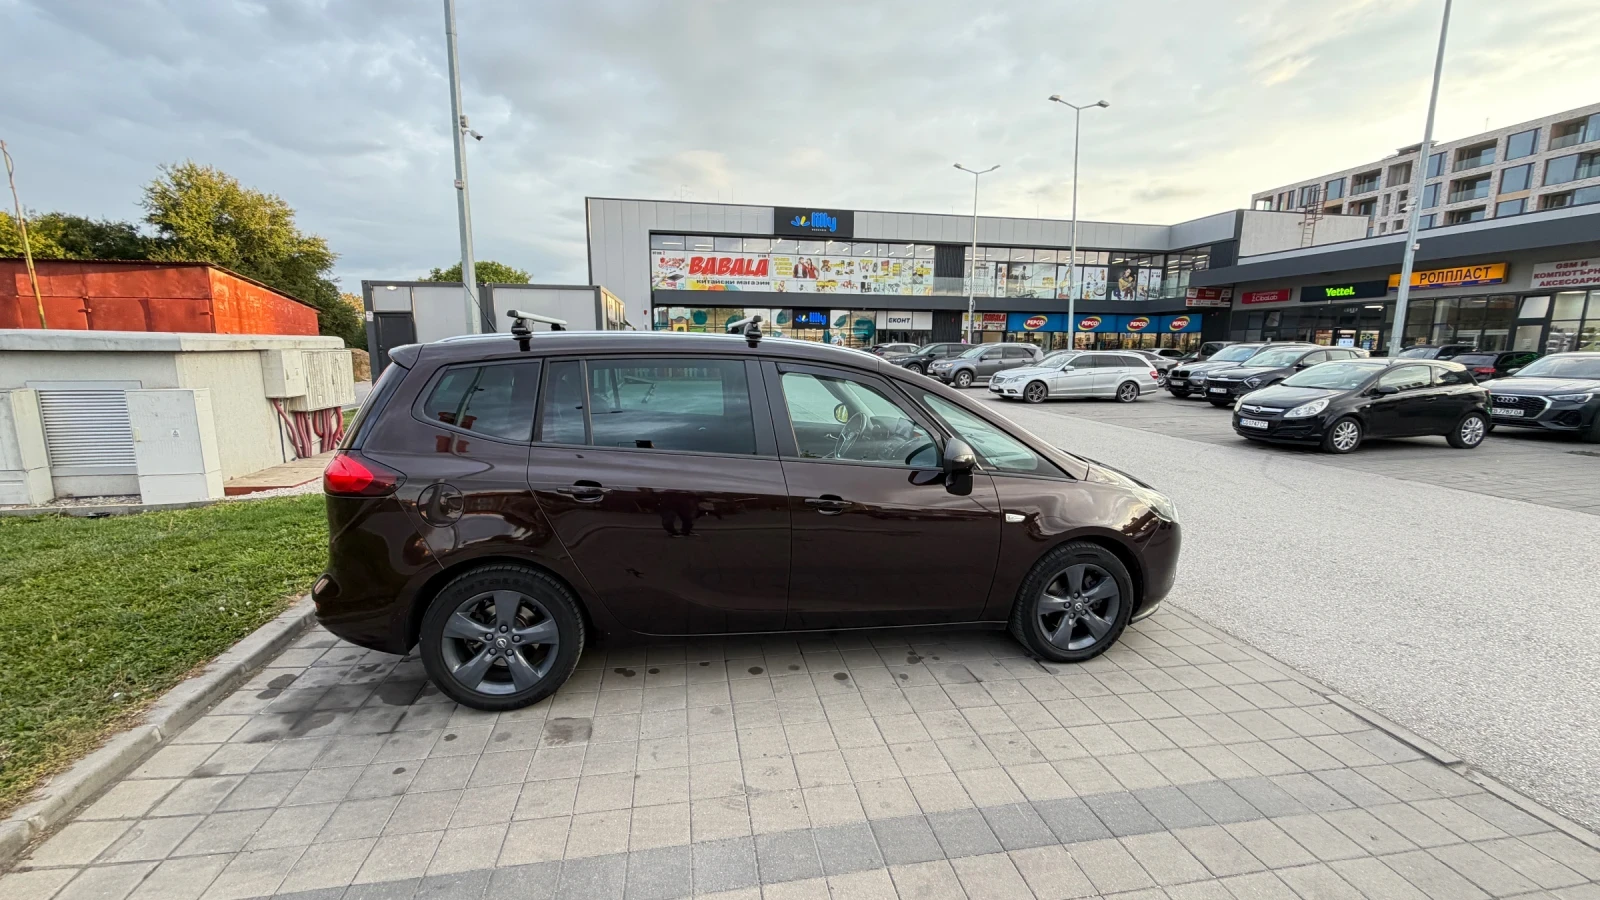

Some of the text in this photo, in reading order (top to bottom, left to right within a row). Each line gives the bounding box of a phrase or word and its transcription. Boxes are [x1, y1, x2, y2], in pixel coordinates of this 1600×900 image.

[811, 212, 837, 232] lilly
[689, 256, 770, 277] BABALA
[1420, 266, 1492, 284] РОЛПЛАСТ
[809, 312, 827, 325] lilly
